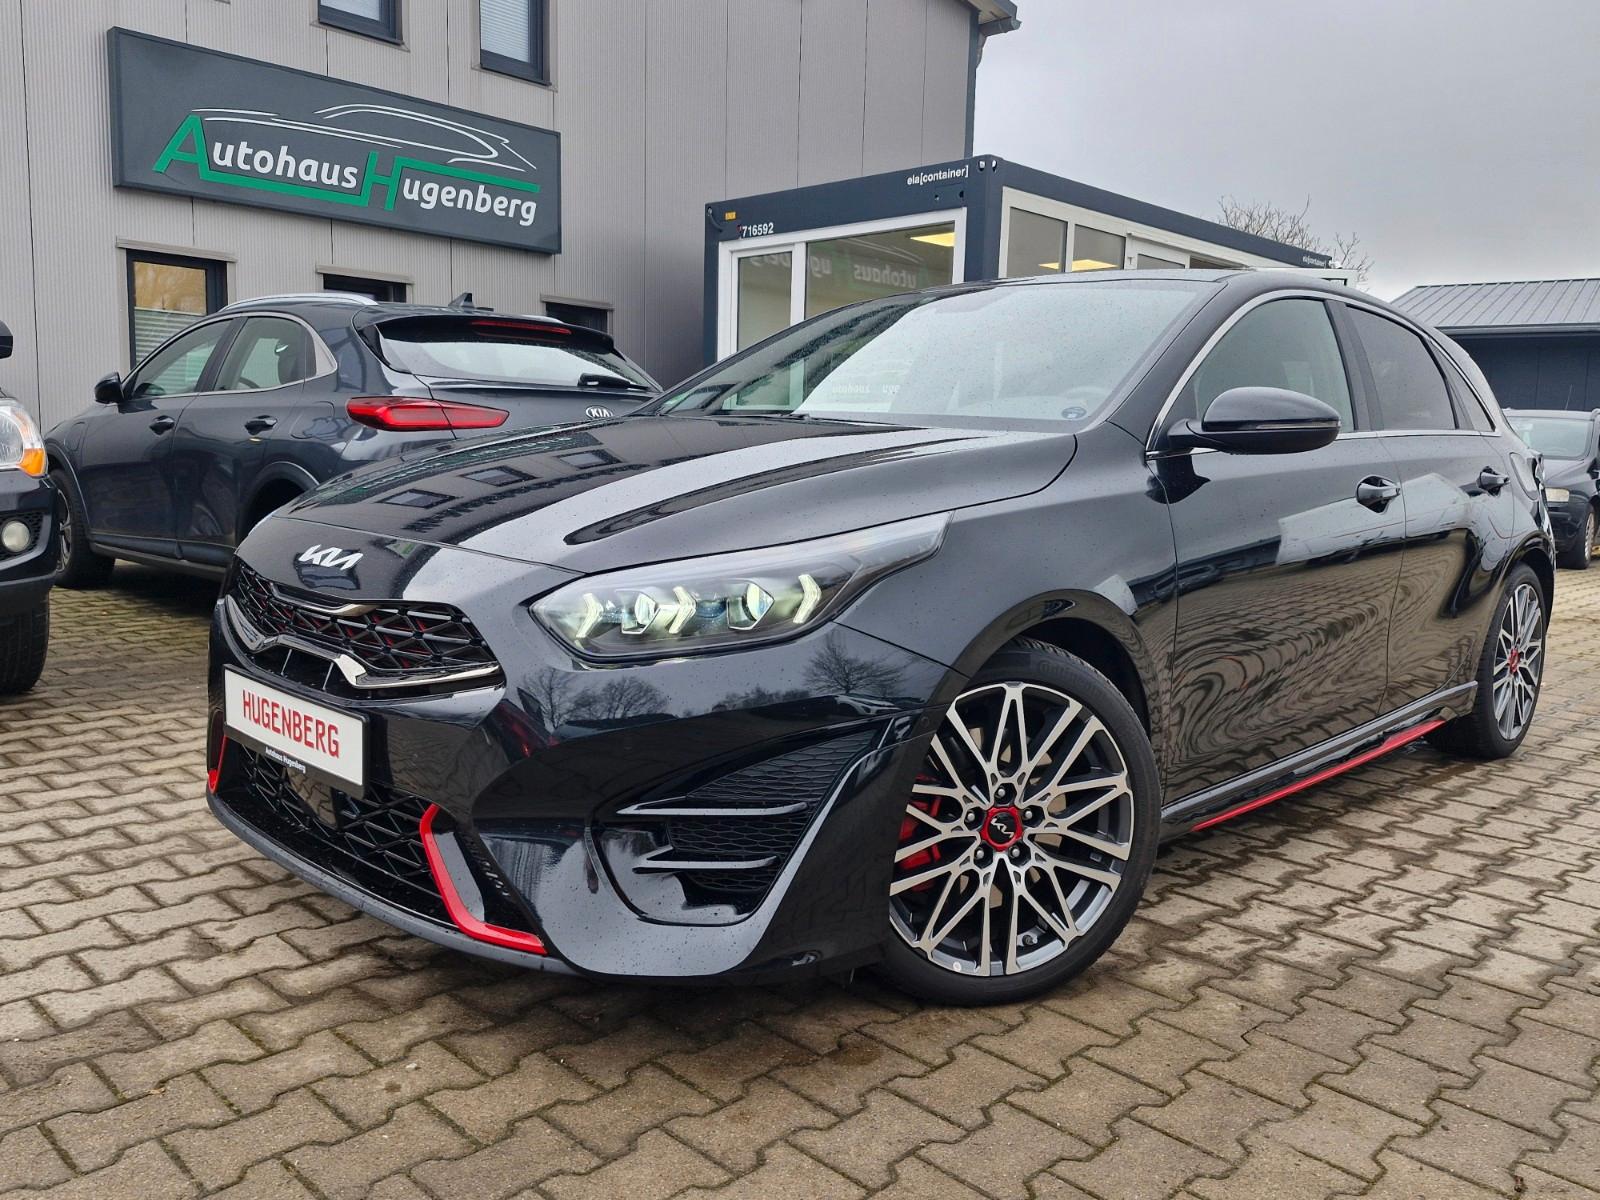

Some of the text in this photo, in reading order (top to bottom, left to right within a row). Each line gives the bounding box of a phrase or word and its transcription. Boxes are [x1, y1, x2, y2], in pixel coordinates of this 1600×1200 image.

[152, 114, 537, 227] Autohaus Hugenberg
[906, 164, 969, 186] ela[container]
[742, 222, 774, 238] 716592
[589, 407, 611, 418] KIA
[242, 689, 340, 759] HUGENBERG
